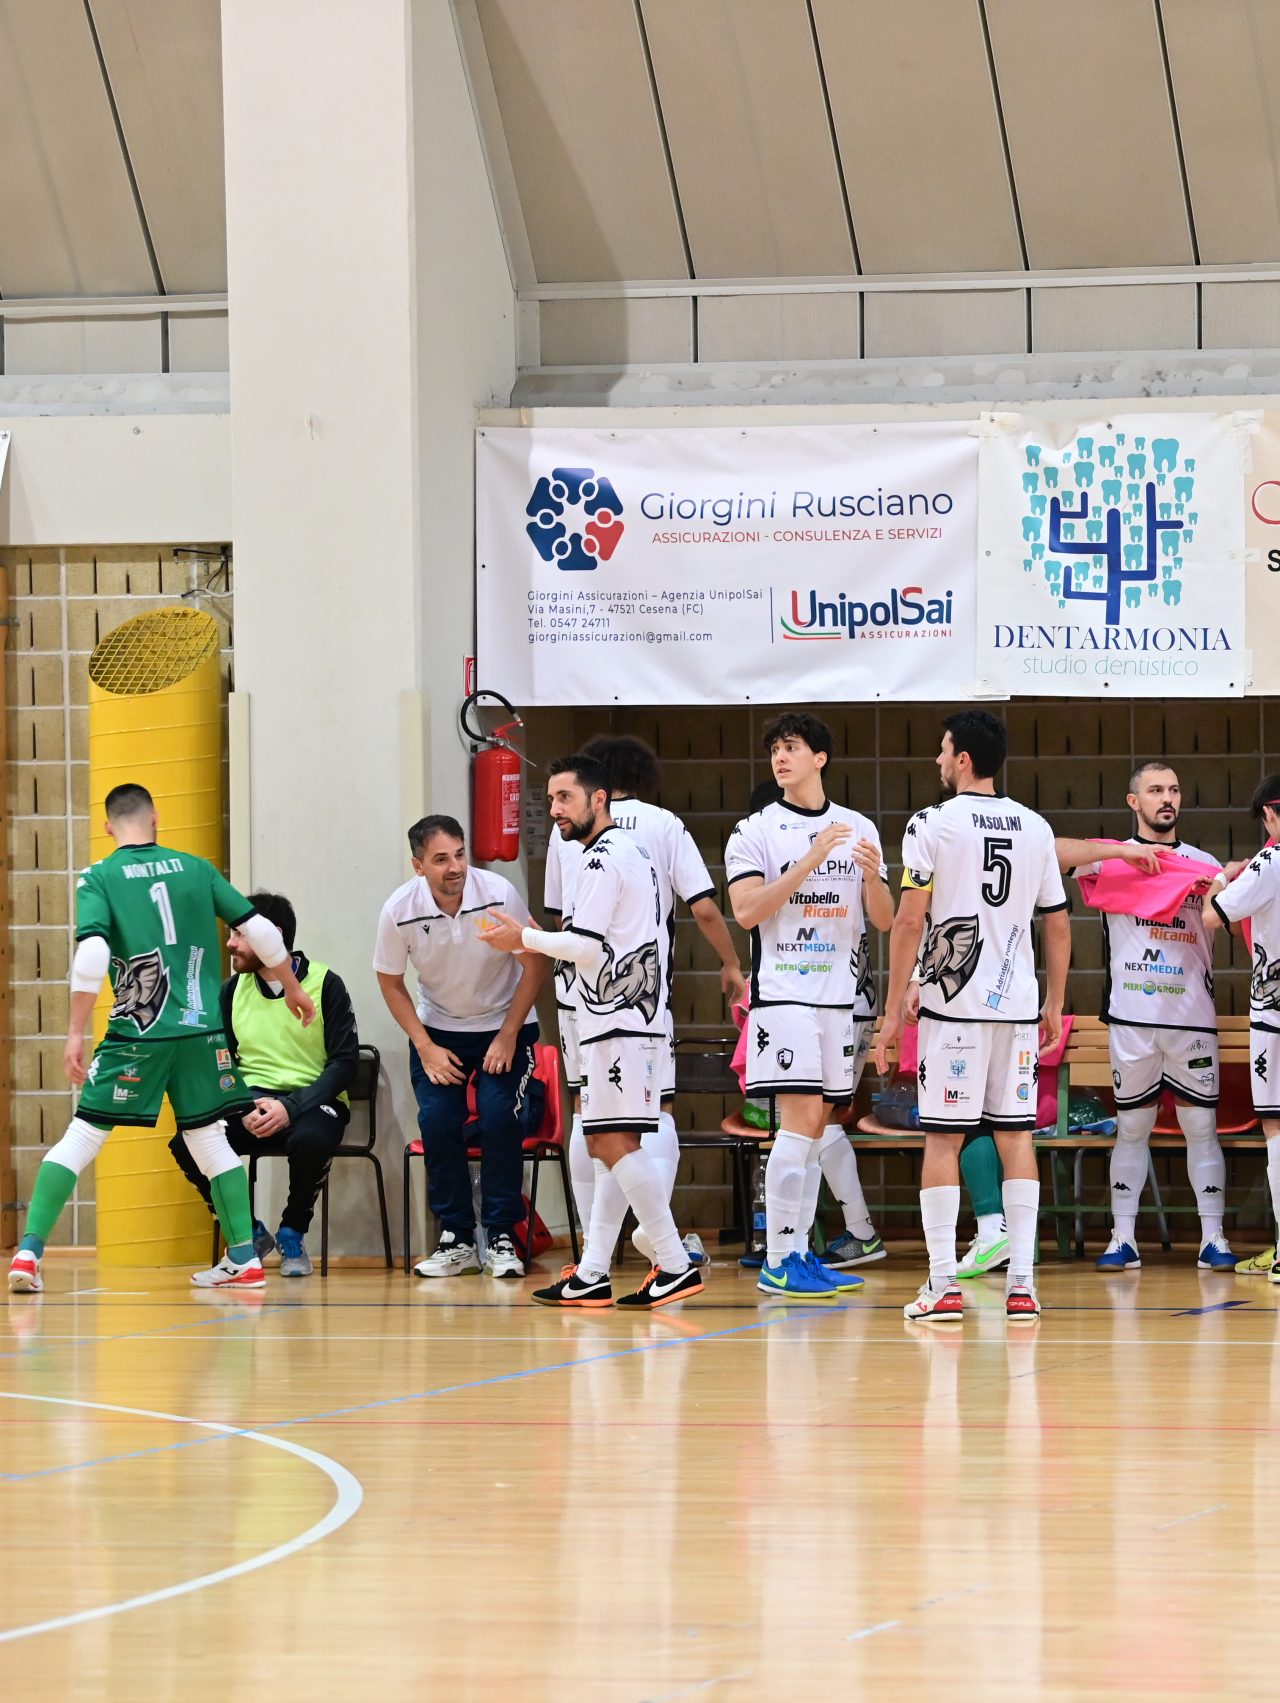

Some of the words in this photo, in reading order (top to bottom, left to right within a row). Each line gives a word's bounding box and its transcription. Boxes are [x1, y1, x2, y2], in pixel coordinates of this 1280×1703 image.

[640, 490, 776, 526] Giorgini
[791, 487, 953, 518] Rusciano
[652, 531, 761, 544] ASSICURAZIONI
[773, 529, 871, 543] CONSULENZA
[876, 529, 884, 541] E
[888, 527, 942, 541] SERVIZI
[527, 590, 573, 603] Giorgini
[577, 590, 648, 601] Assicurazioni
[661, 590, 705, 602] Agenzia
[709, 589, 763, 602] UnipolSai
[527, 604, 544, 615] Via
[548, 604, 596, 616] Masini,7
[607, 604, 635, 614] 47521
[639, 604, 678, 614] Cesena
[682, 603, 704, 616] (FC)
[790, 587, 953, 640] UnipolSai
[527, 618, 546, 628] Tel.
[550, 618, 577, 628] 0547
[581, 618, 610, 628] 24711
[528, 631, 713, 644] giorginiassicurazioni@gmail.com
[860, 628, 953, 640] ASSICURAZIONI
[992, 624, 1232, 652] DENTARMONIA
[1022, 654, 1088, 676] studio
[1095, 654, 1199, 677] dentistico
[972, 813, 1022, 831] PASOLINI
[122, 858, 184, 879] MONTALTI
[981, 836, 1013, 907] 5
[789, 892, 840, 904] Vitobello
[149, 881, 178, 946] 1
[1149, 927, 1198, 944] Ricambi
[776, 943, 836, 952] NEXTMEDIA
[775, 963, 797, 972] PIERI
[1124, 962, 1184, 976] NEXTMEDIA
[1123, 982, 1142, 991] PIERI
[1157, 985, 1186, 995] GROUP
